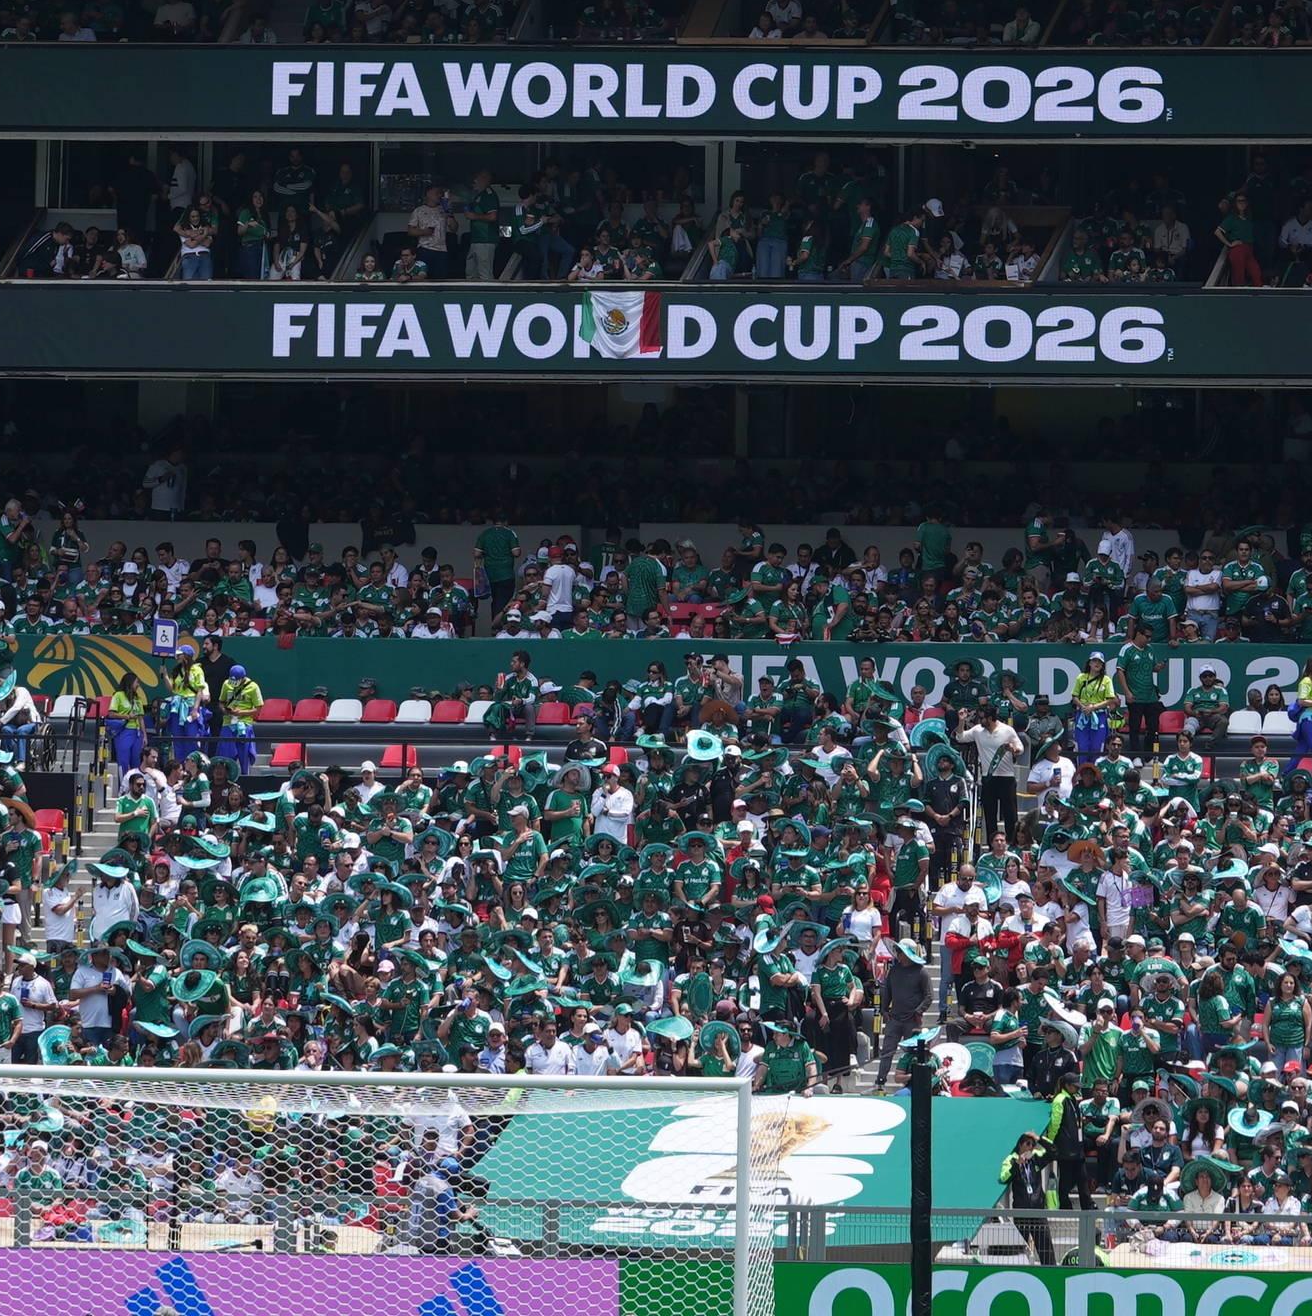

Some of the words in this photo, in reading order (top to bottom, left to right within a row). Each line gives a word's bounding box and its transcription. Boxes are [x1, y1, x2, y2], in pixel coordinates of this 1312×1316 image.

[271, 61, 431, 117] FIFA
[442, 61, 717, 119] WORLD
[732, 63, 883, 120] CUP
[897, 65, 1165, 124] 2026
[272, 302, 431, 358] FIFA
[443, 302, 718, 360] WOD
[733, 303, 884, 361] CUP
[899, 305, 1167, 364] 2026
[698, 654, 825, 706] FA
[839, 655, 1084, 707] WOLD
[1104, 656, 1232, 707] UP
[689, 1184, 790, 1196] FIA
